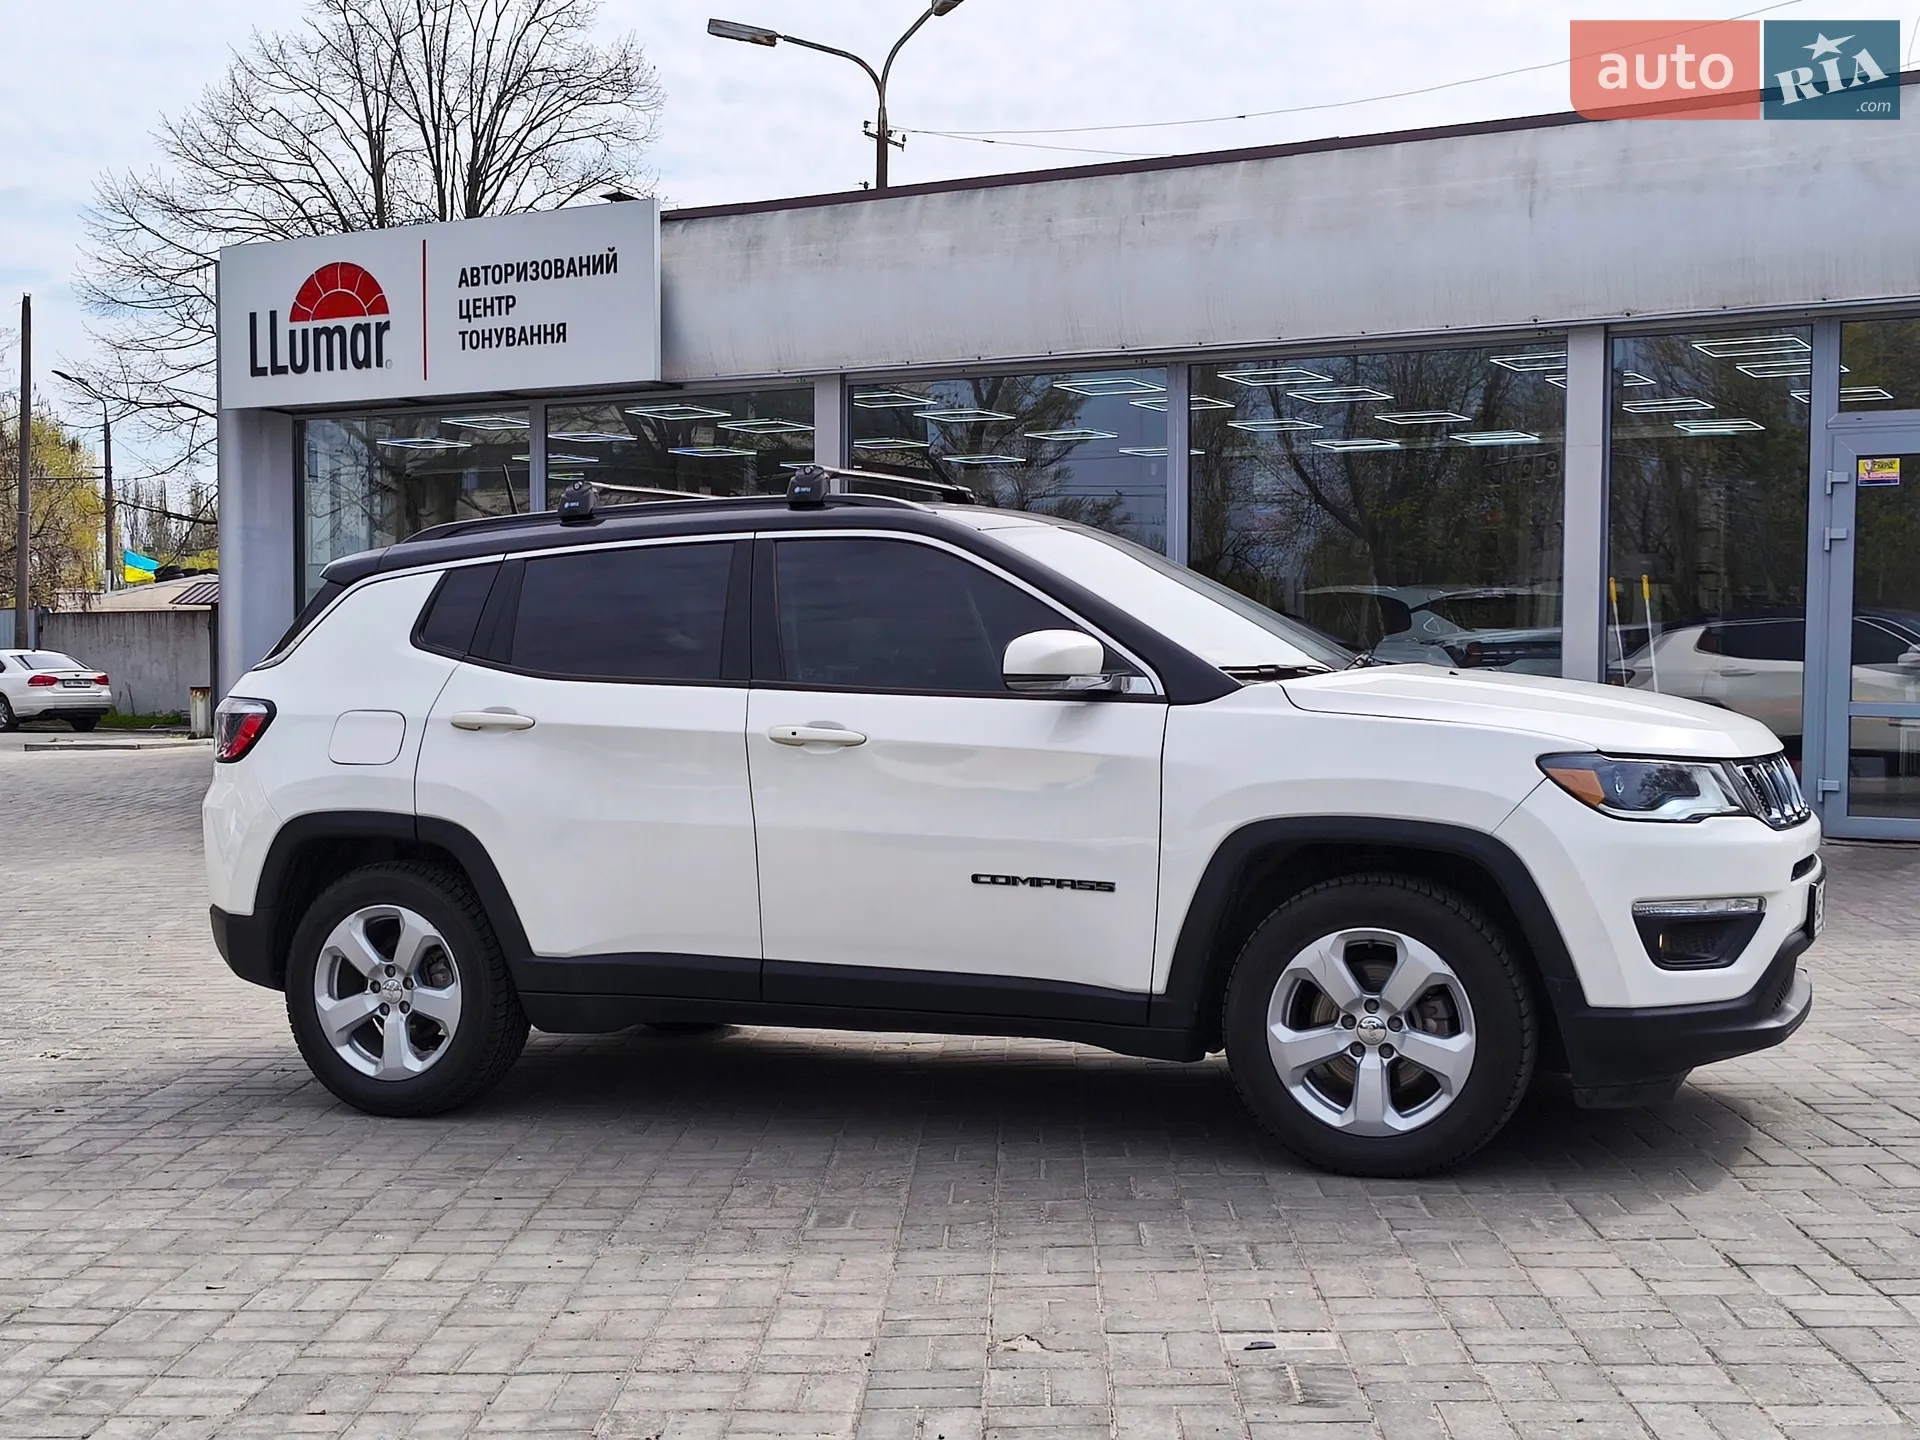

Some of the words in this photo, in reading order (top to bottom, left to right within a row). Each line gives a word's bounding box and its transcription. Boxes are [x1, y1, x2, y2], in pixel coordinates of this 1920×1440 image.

[457, 247, 618, 288] АВТОРИЗОВАНИЙ
[458, 295, 517, 322] ЦЕНТР
[249, 310, 391, 377] LLumar
[458, 322, 567, 351] ТОНУВАННЯ
[971, 873, 1116, 892] COMPASS
